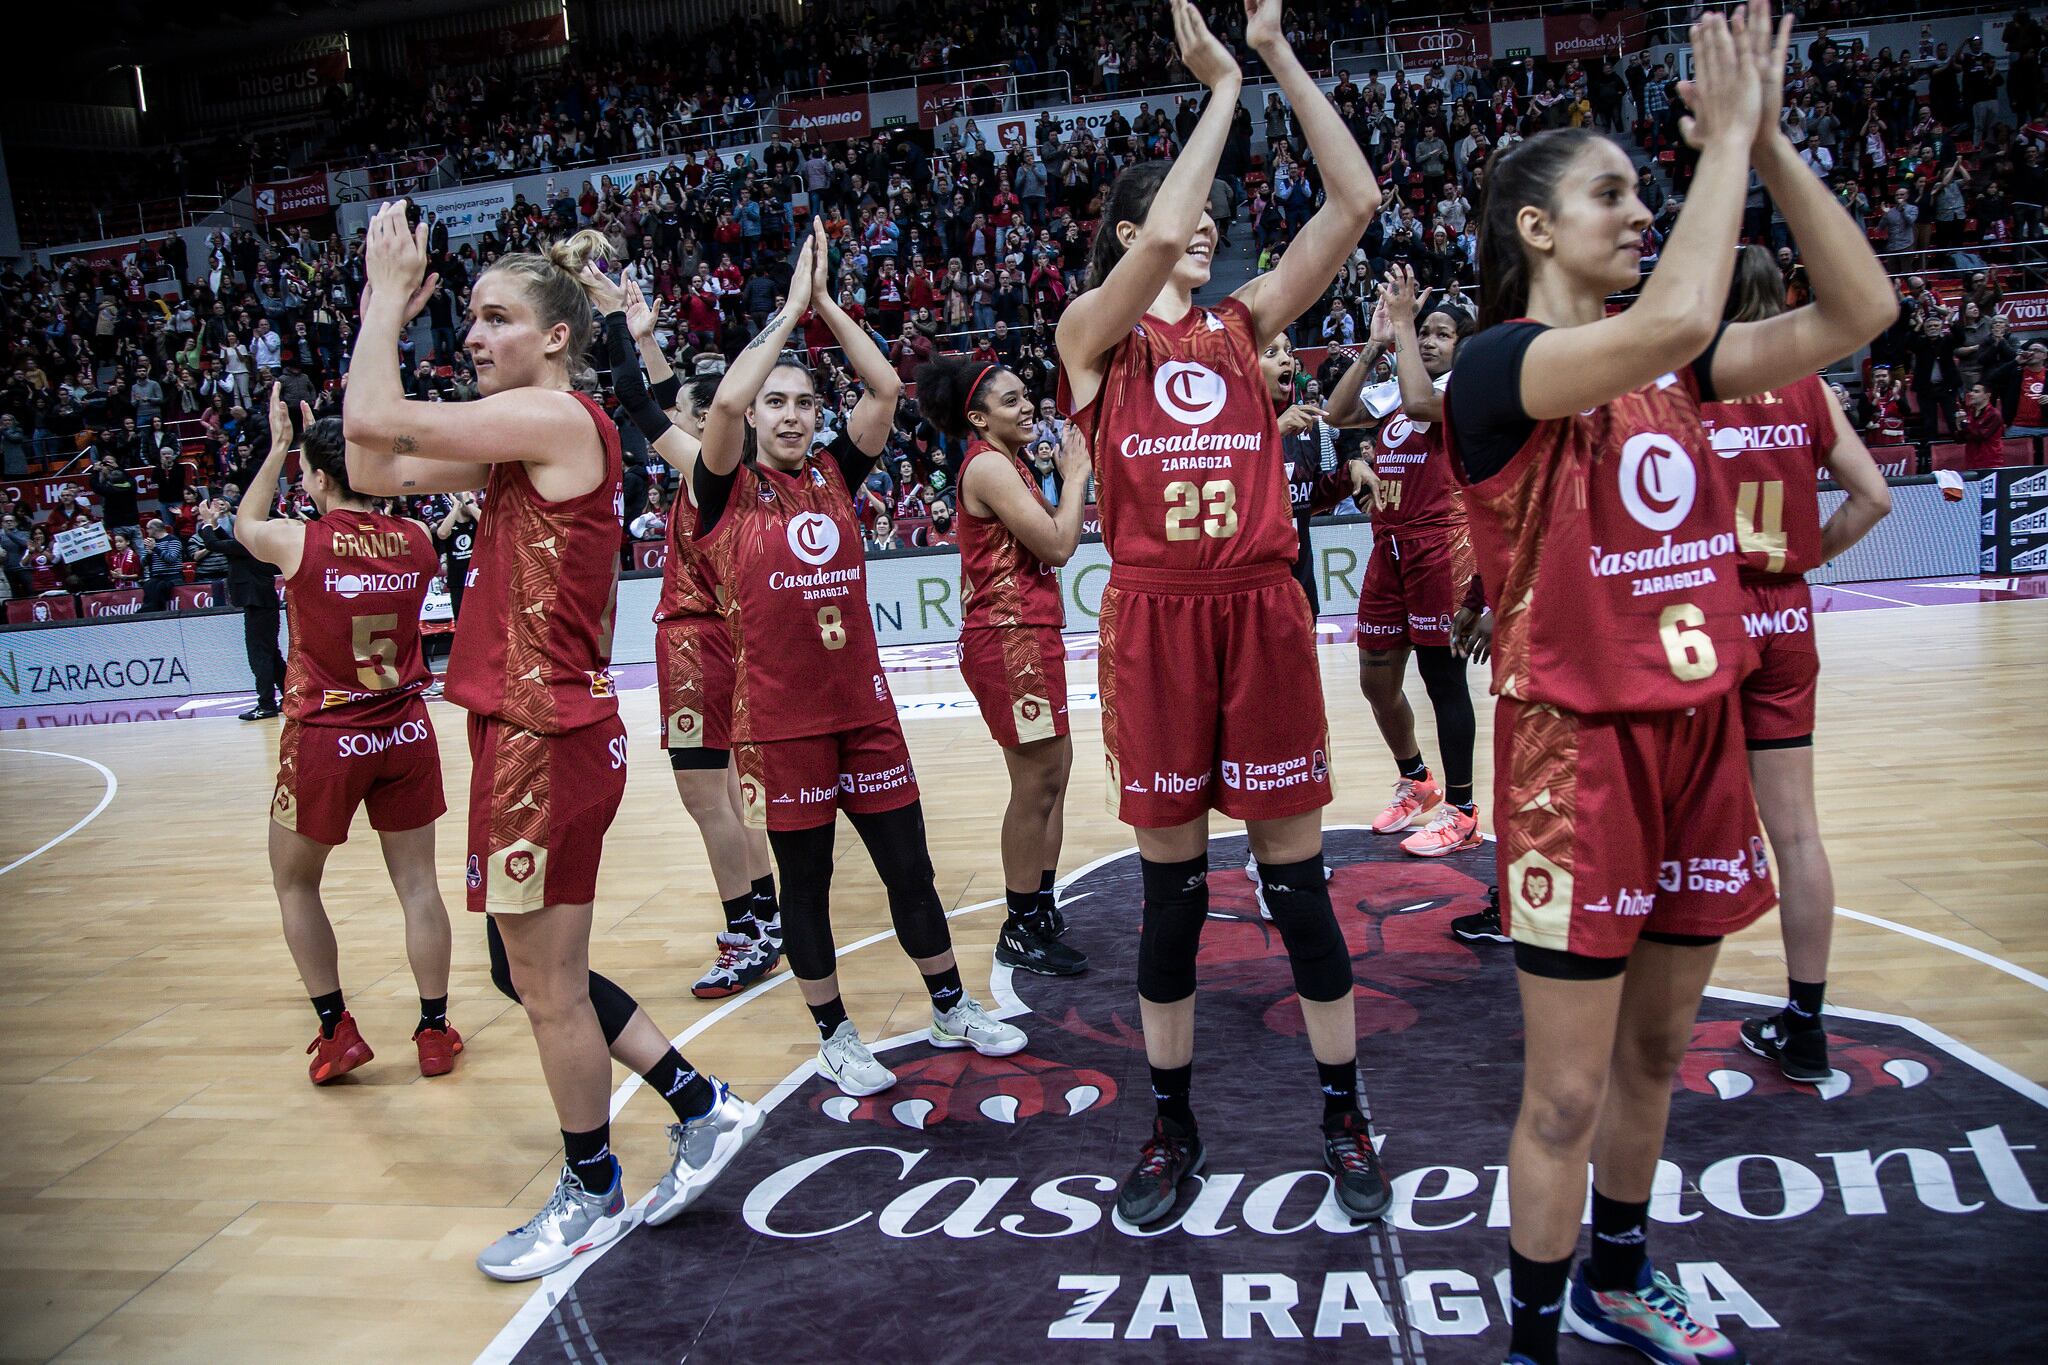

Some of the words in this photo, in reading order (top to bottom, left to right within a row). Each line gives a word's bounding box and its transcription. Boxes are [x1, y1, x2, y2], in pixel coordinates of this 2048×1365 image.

[791, 110, 862, 128] ARABINGO
[886, 117, 904, 125] EXIT
[282, 195, 326, 210] DEPORTE
[436, 196, 505, 213] @enjoyzaragoza
[1120, 428, 1262, 458] Casademont
[1161, 456, 1232, 472] ZARAGOZA
[1163, 479, 1239, 541] 23
[1735, 480, 1787, 573] 4
[332, 531, 412, 558] GRANDE
[769, 565, 860, 590] Casademont
[1632, 567, 1717, 597] ZARAGOZA
[803, 585, 849, 600] ZARAGOZA
[817, 605, 847, 651] 8
[351, 613, 399, 691] 5
[1659, 602, 1719, 682] 6
[28, 656, 190, 694] ZARAGOZA
[857, 764, 905, 782] Zaragoza
[1246, 756, 1307, 776] Zaragoza
[859, 776, 908, 793] DEPORTE
[1246, 772, 1309, 791] DEPORTE
[1047, 1260, 1781, 1340] ZARAGA
